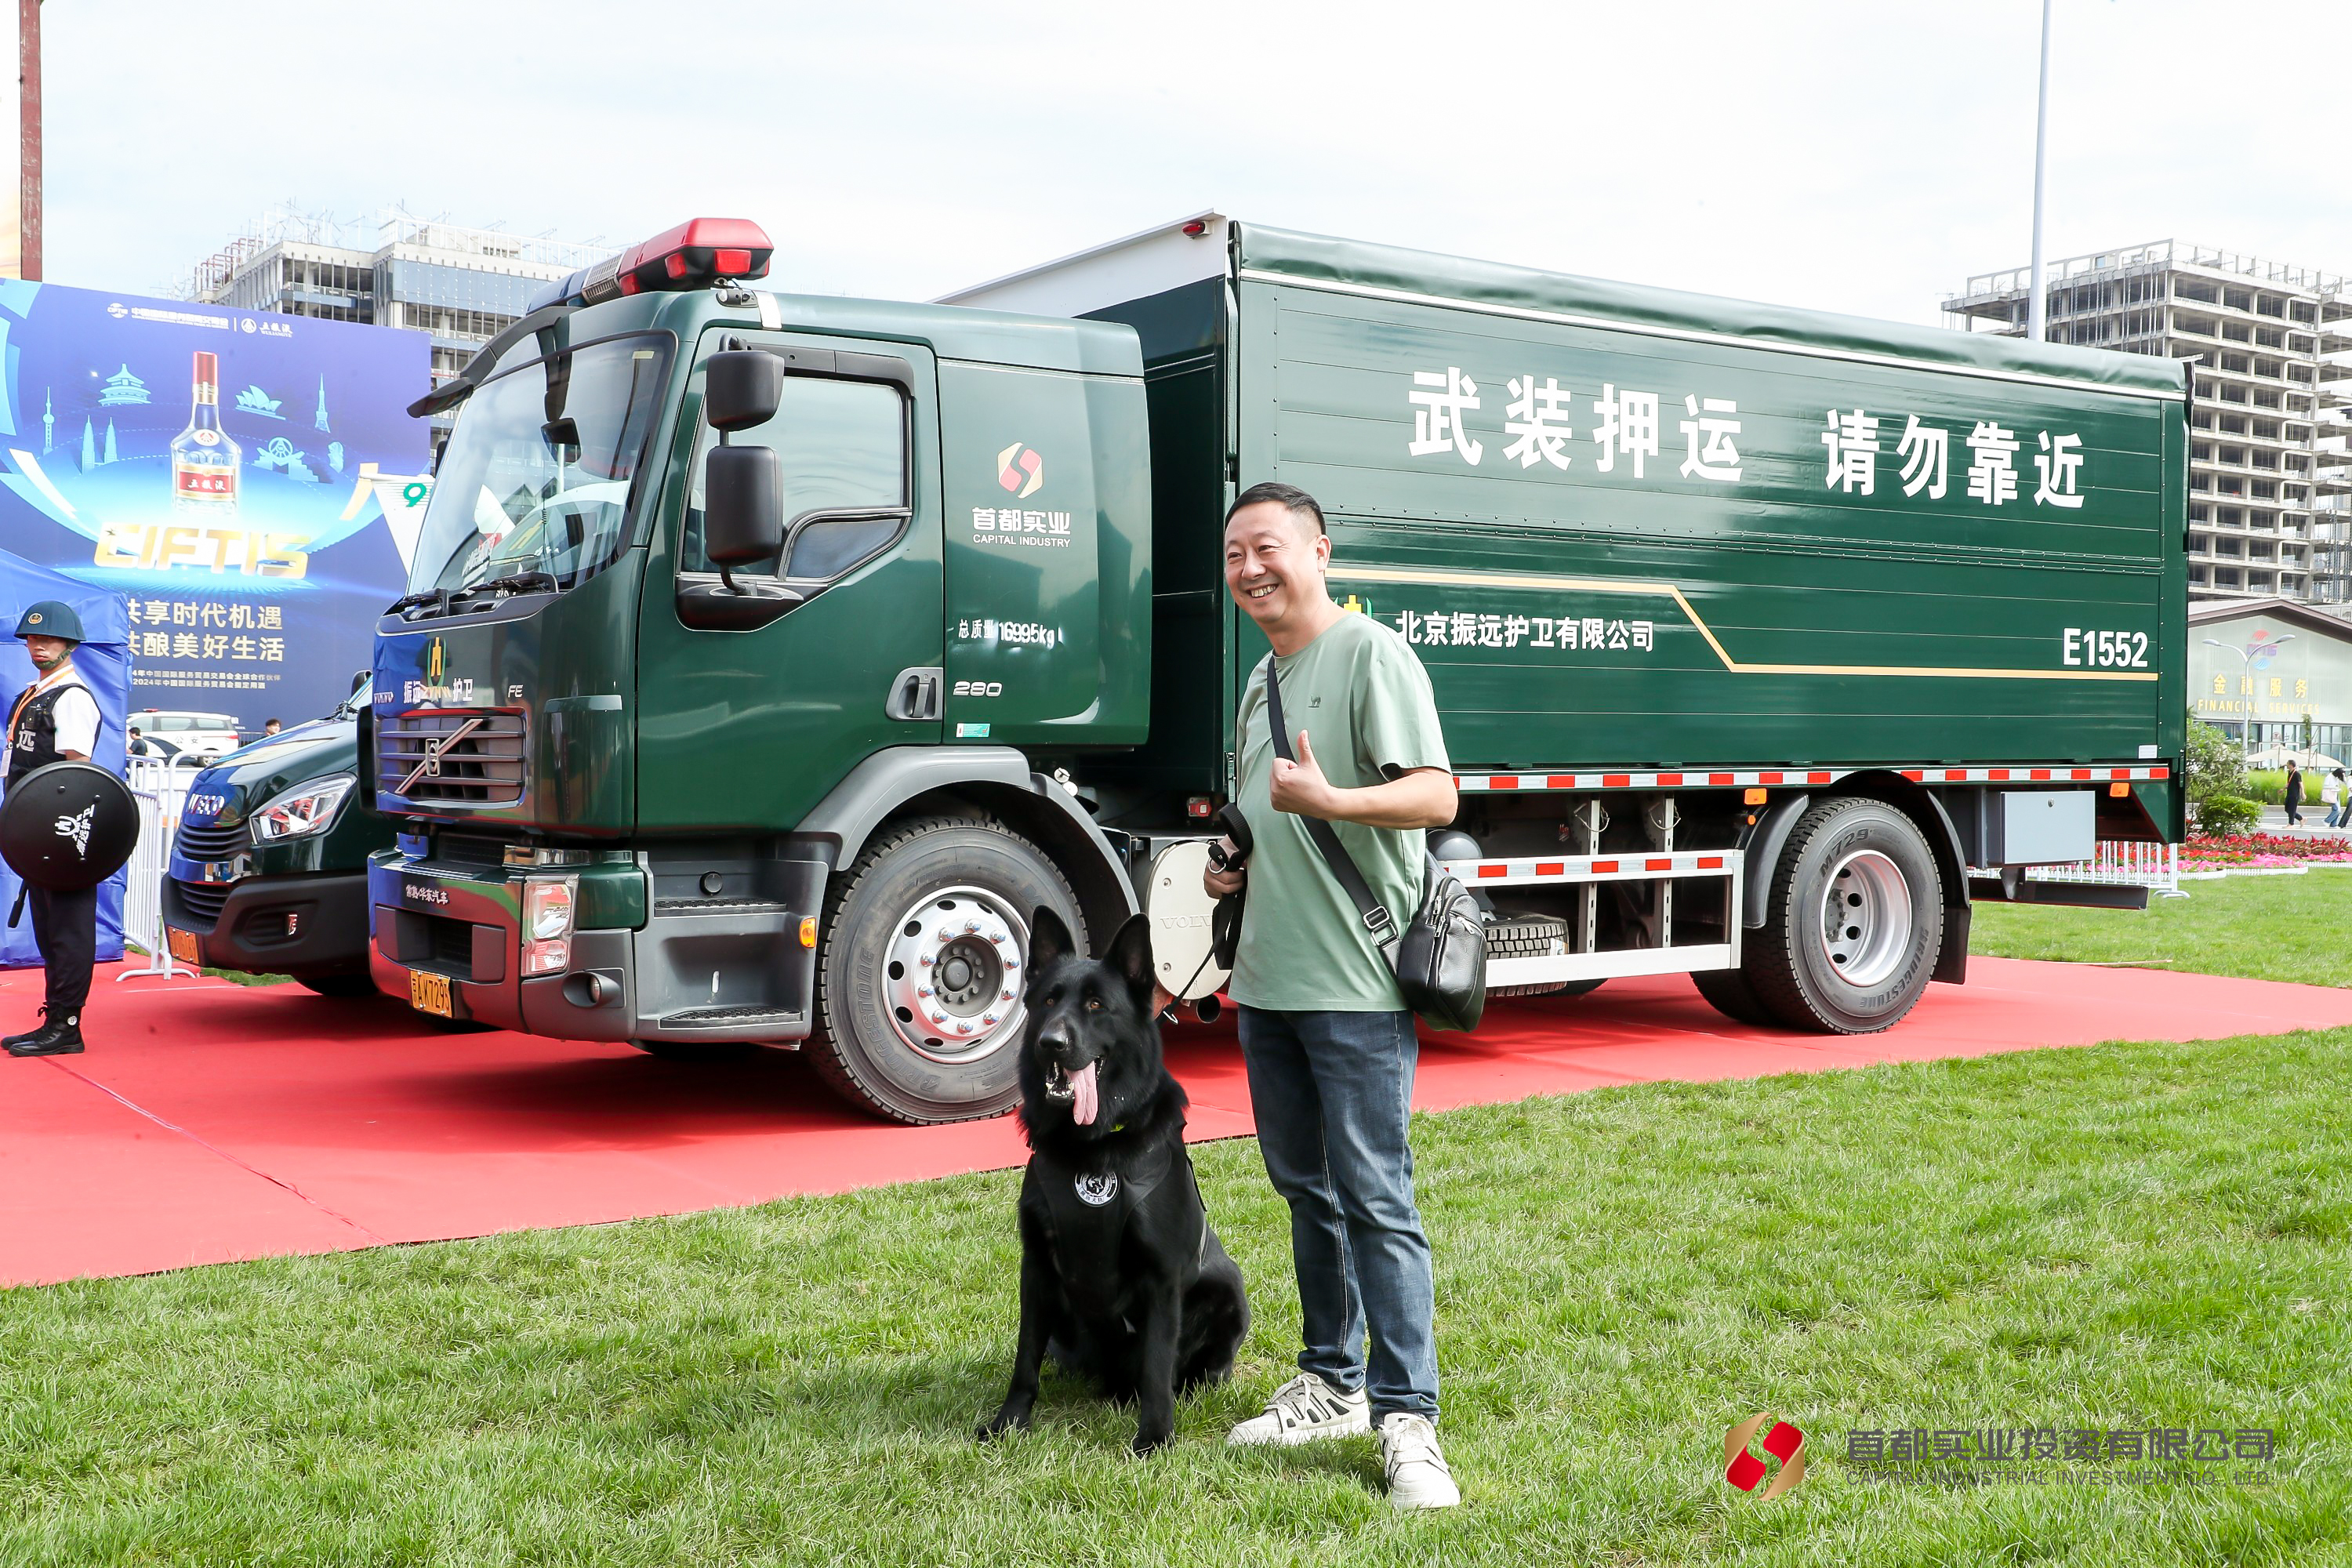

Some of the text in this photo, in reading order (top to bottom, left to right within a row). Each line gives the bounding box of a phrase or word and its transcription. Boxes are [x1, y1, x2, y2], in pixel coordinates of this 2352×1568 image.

[1408, 366, 2085, 509] 武装押运 请勿靠近
[972, 507, 1071, 535] 首都实业
[93, 521, 311, 579] CIFTIS
[973, 534, 1071, 548] CAPITAL INDUSTRY
[958, 619, 1055, 650] 总质量 16995kg
[1395, 610, 1654, 652] 北京振远护卫有限公司
[2063, 627, 2149, 667] E1552
[453, 678, 474, 702] 护卫
[508, 684, 524, 699] FE
[953, 681, 1003, 697] 280
[2213, 673, 2308, 699] 金融服务
[2198, 699, 2320, 715] FINANCIAL SERVICES
[1160, 915, 1213, 929] VOLV
